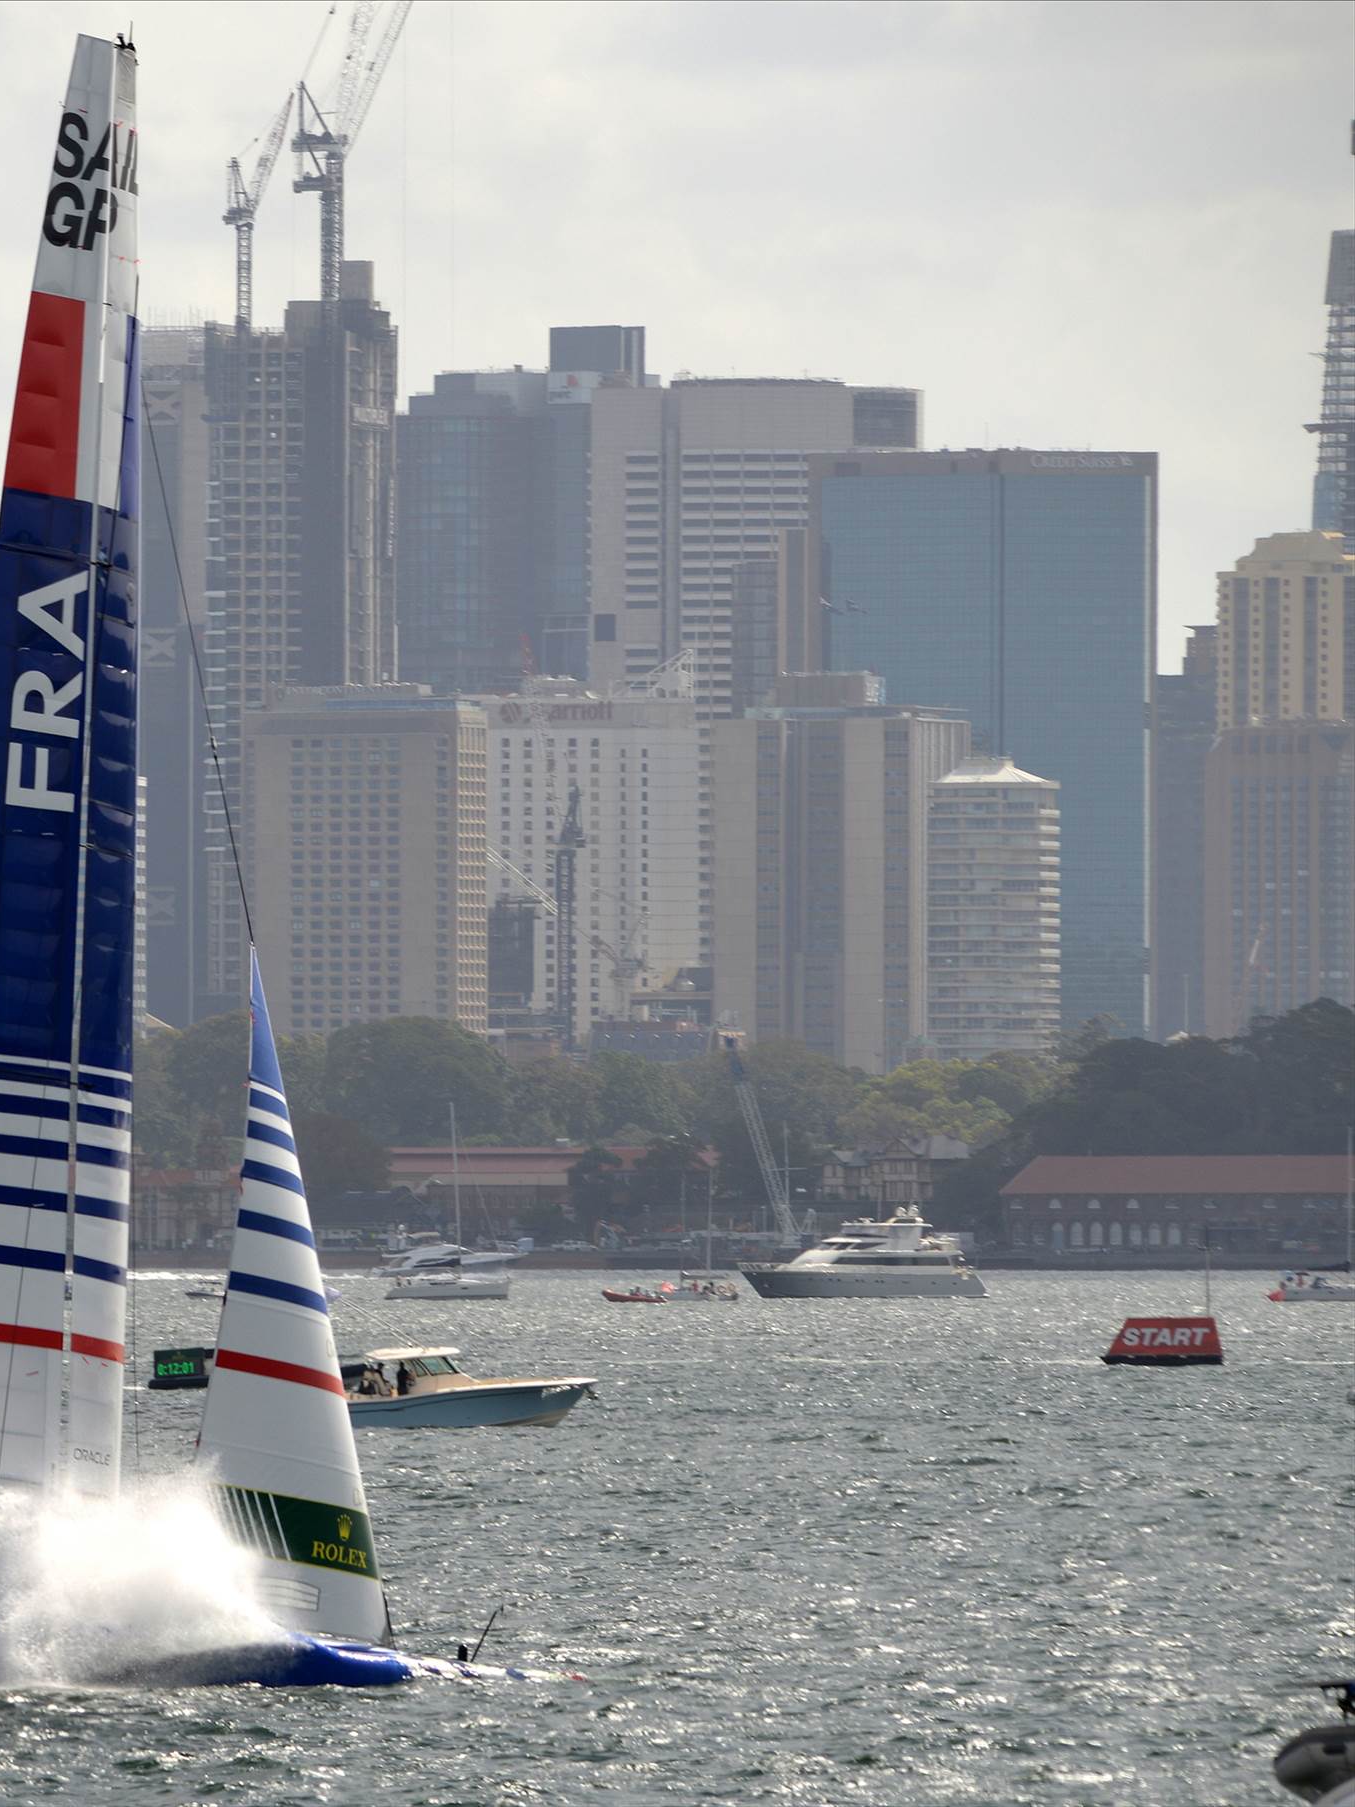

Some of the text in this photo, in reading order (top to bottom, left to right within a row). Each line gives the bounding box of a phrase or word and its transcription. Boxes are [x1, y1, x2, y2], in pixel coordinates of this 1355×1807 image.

[43, 182, 118, 251] GP
[5, 570, 89, 813] FRA
[523, 700, 613, 723] arriott
[1122, 1327, 1211, 1346] START
[73, 1447, 111, 1467] ORACLE
[311, 1540, 367, 1569] ROLEX
